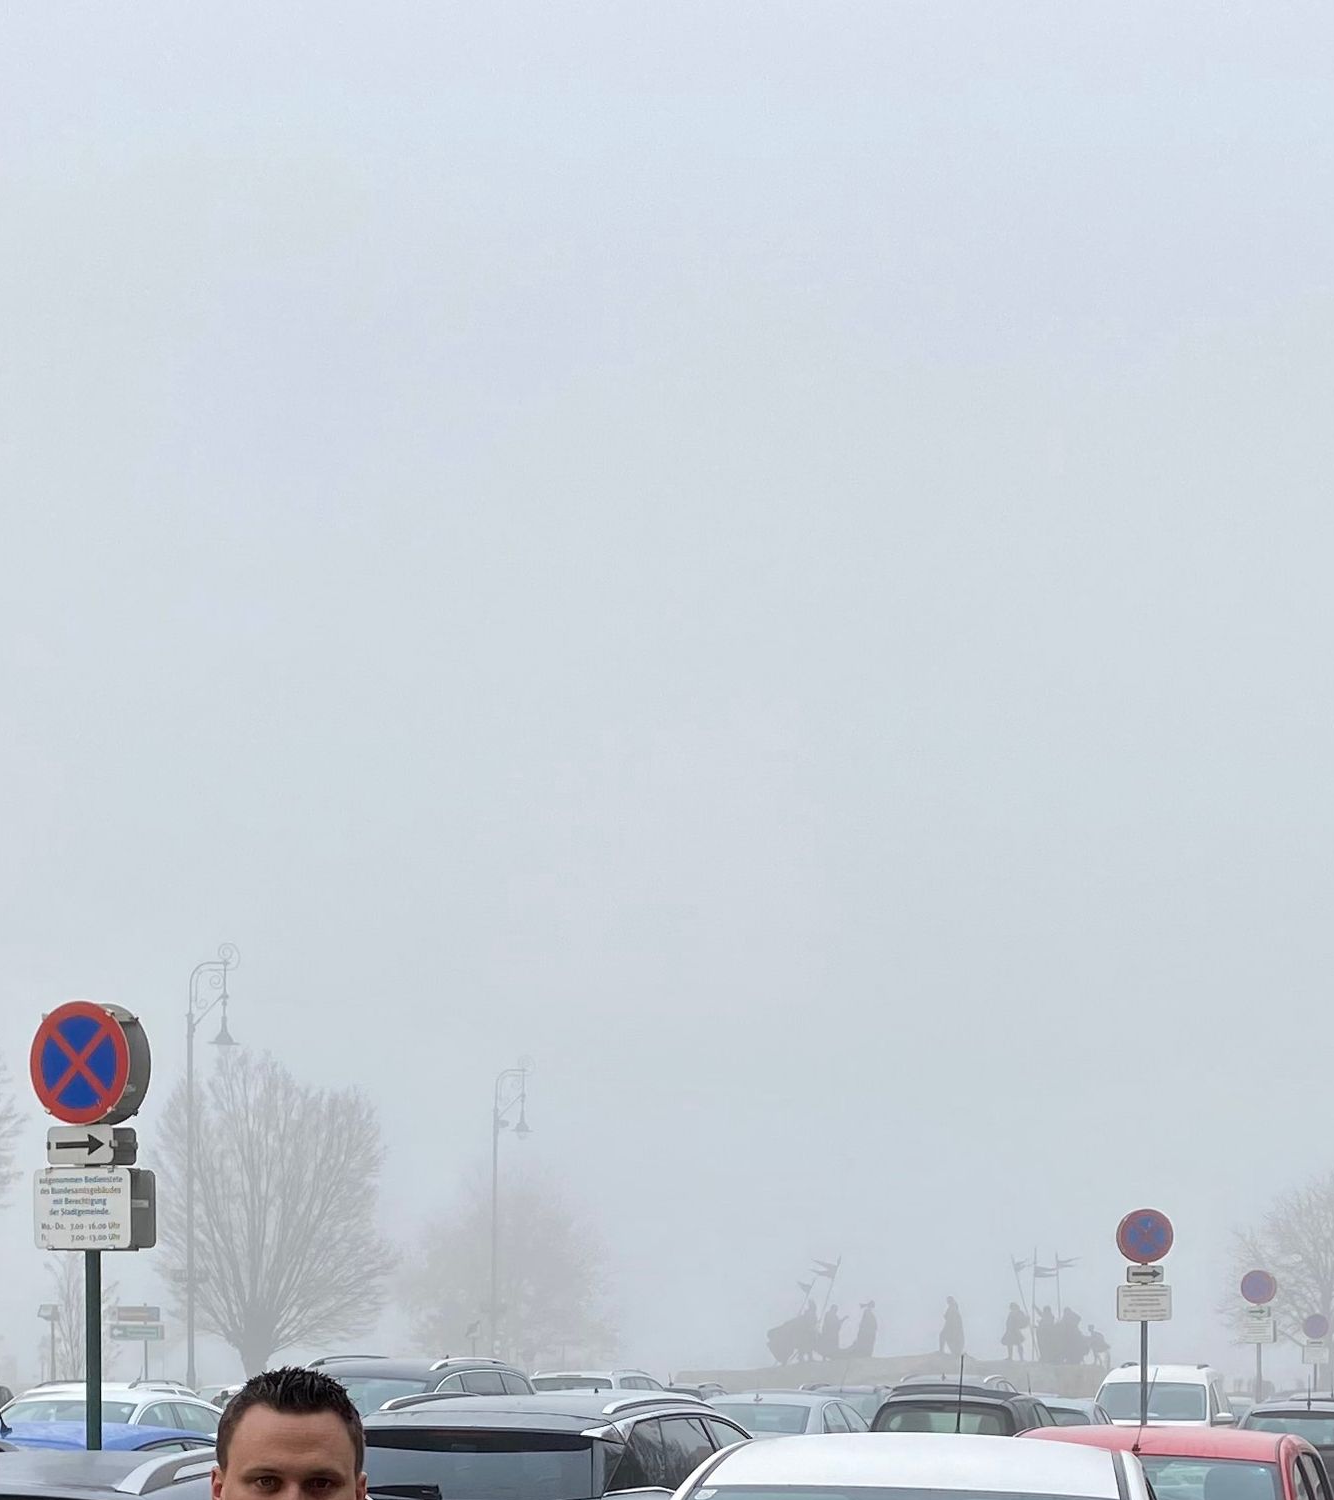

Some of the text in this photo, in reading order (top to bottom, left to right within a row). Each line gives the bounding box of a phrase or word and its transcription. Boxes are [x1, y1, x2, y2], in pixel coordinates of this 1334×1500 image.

[84, 1175, 123, 1183] Bedienstete
[40, 1187, 50, 1195] des
[64, 1198, 107, 1207] Berechtigung
[108, 1222, 121, 1230] Uhr
[108, 1232, 121, 1240] Uhr
